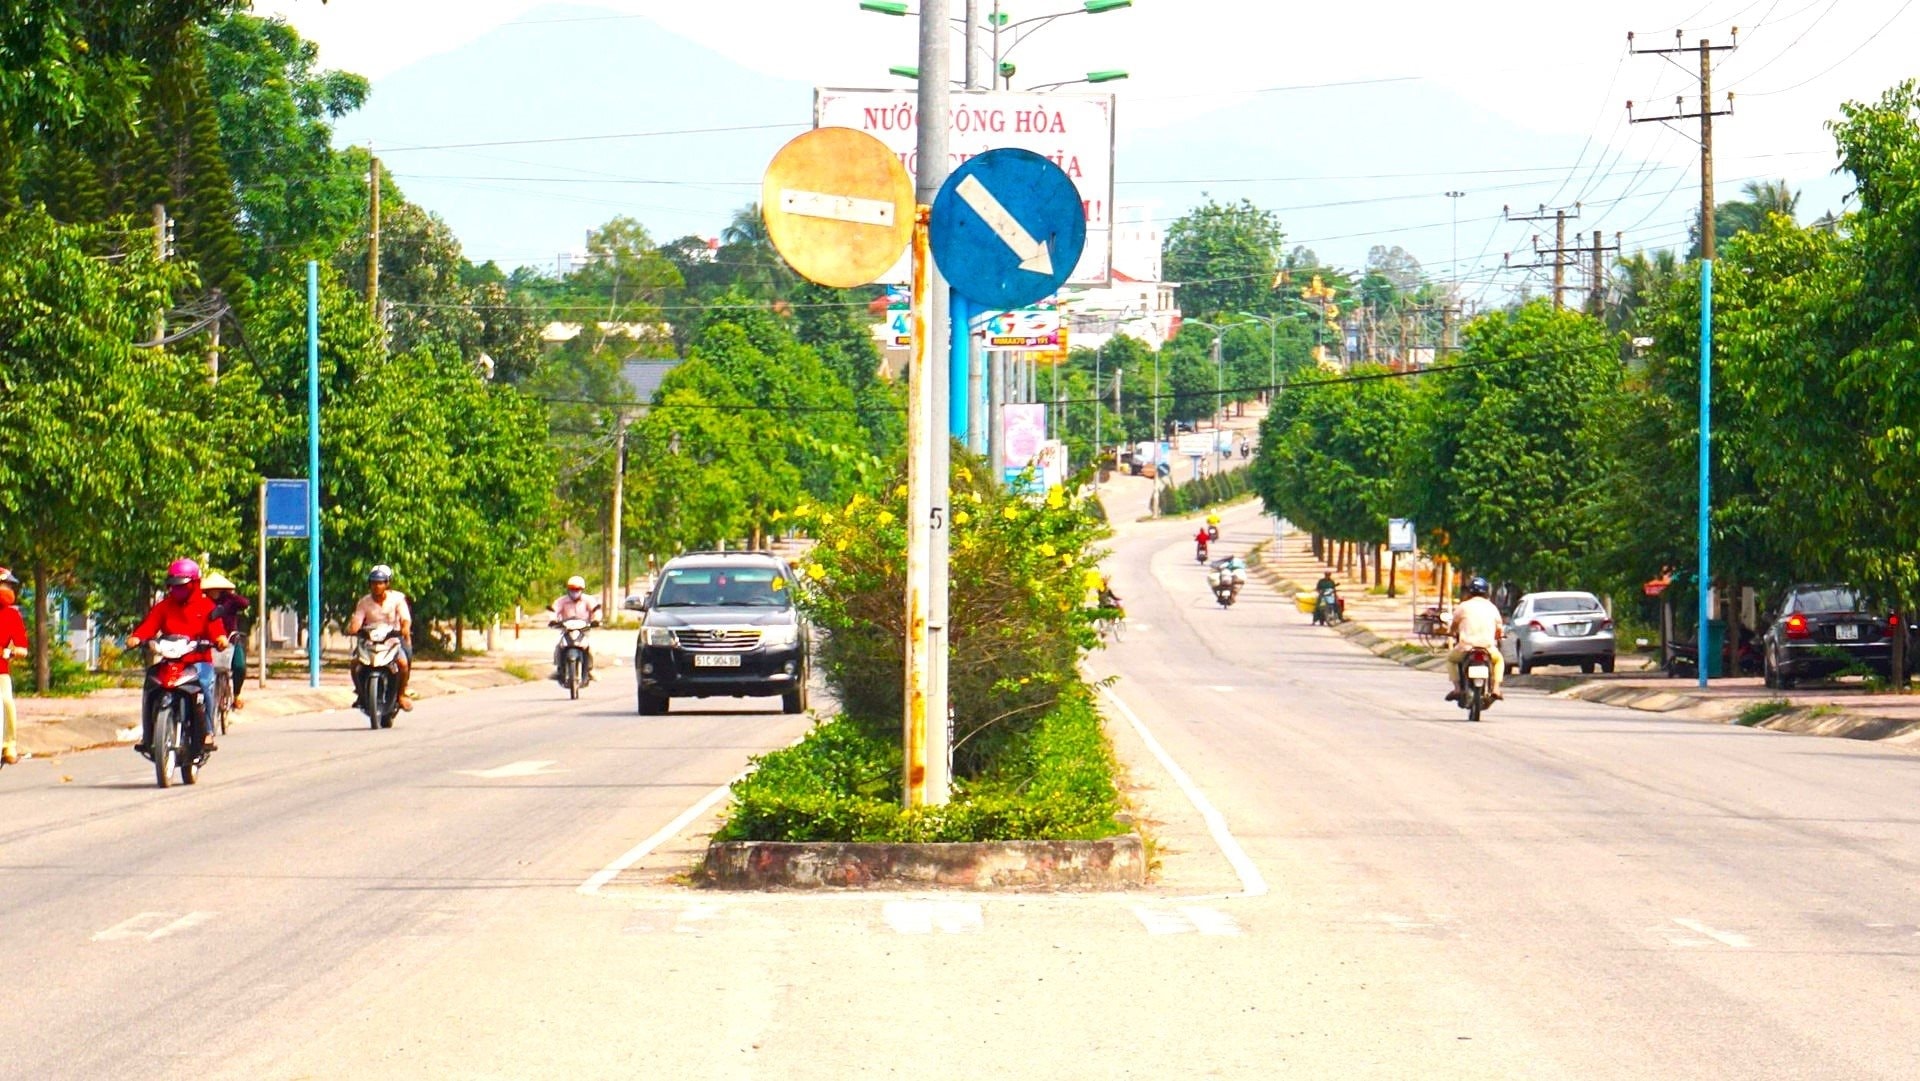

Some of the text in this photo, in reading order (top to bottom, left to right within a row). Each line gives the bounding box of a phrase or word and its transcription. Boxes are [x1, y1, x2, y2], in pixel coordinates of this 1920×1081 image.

[863, 101, 920, 130] NƯỚ
[1015, 105, 1066, 133] HÒA
[930, 507, 943, 529] 5
